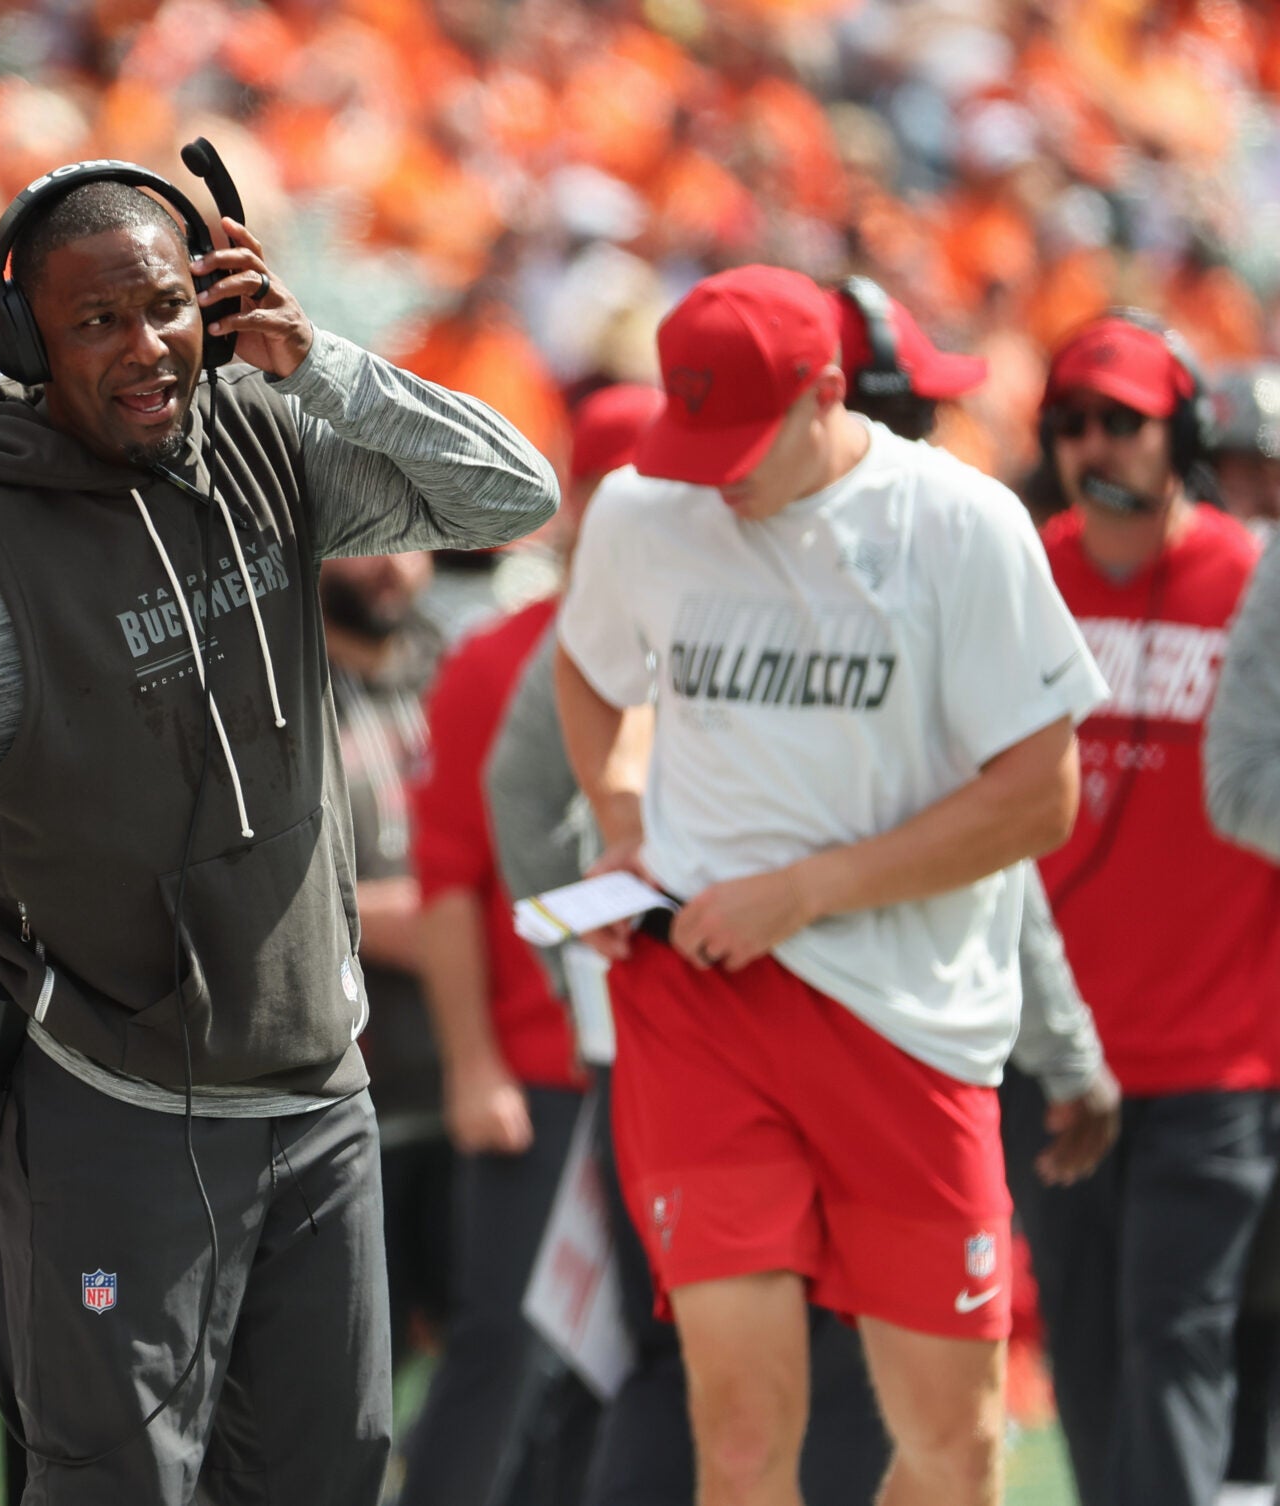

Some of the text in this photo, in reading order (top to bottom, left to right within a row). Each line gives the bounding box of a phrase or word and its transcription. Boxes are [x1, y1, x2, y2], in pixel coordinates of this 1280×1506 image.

[116, 542, 289, 658] BUCANEERS
[138, 542, 258, 606] TAP BY
[86, 1288, 113, 1307] NFL
